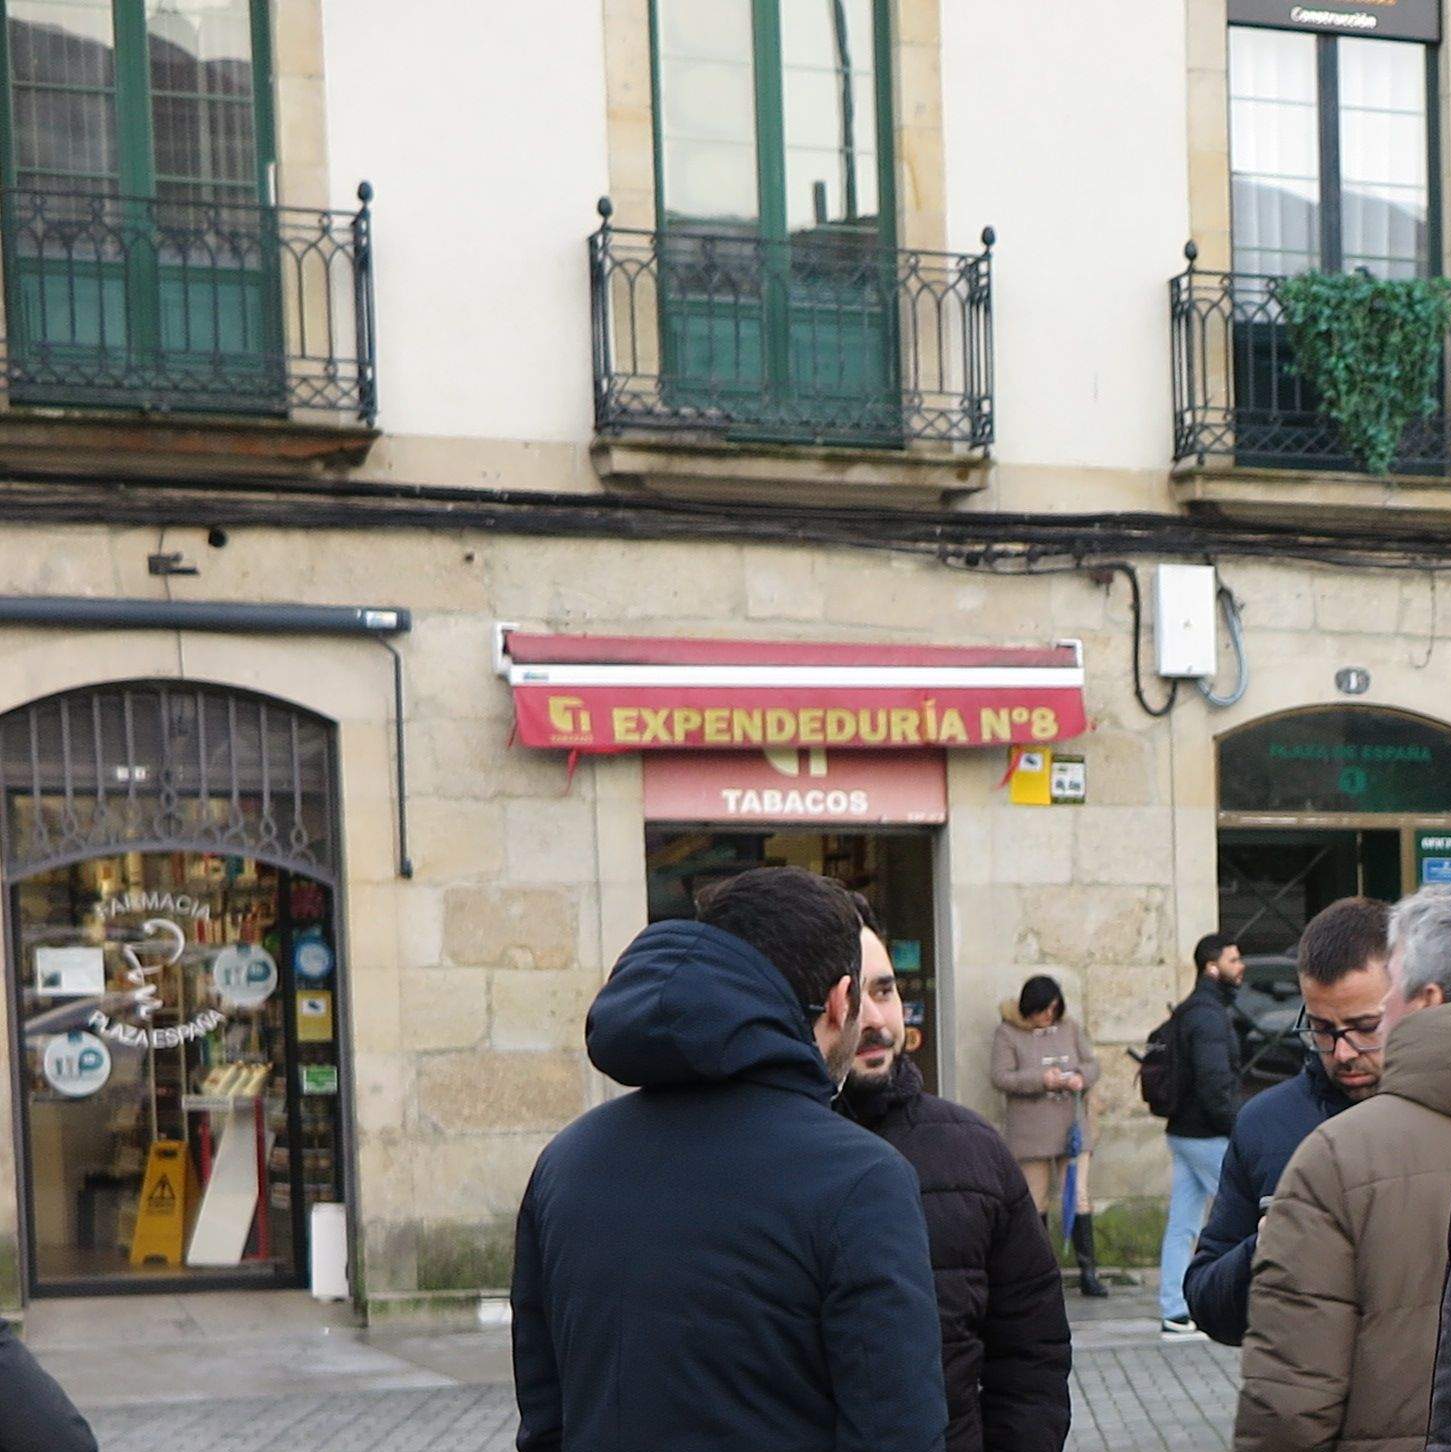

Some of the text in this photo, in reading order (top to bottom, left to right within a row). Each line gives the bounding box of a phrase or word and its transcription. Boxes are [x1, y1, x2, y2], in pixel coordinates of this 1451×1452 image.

[611, 699, 968, 745] EXPENDEDURÍA
[721, 788, 868, 815] TABACOS
[88, 1010, 149, 1048] PLAZA
